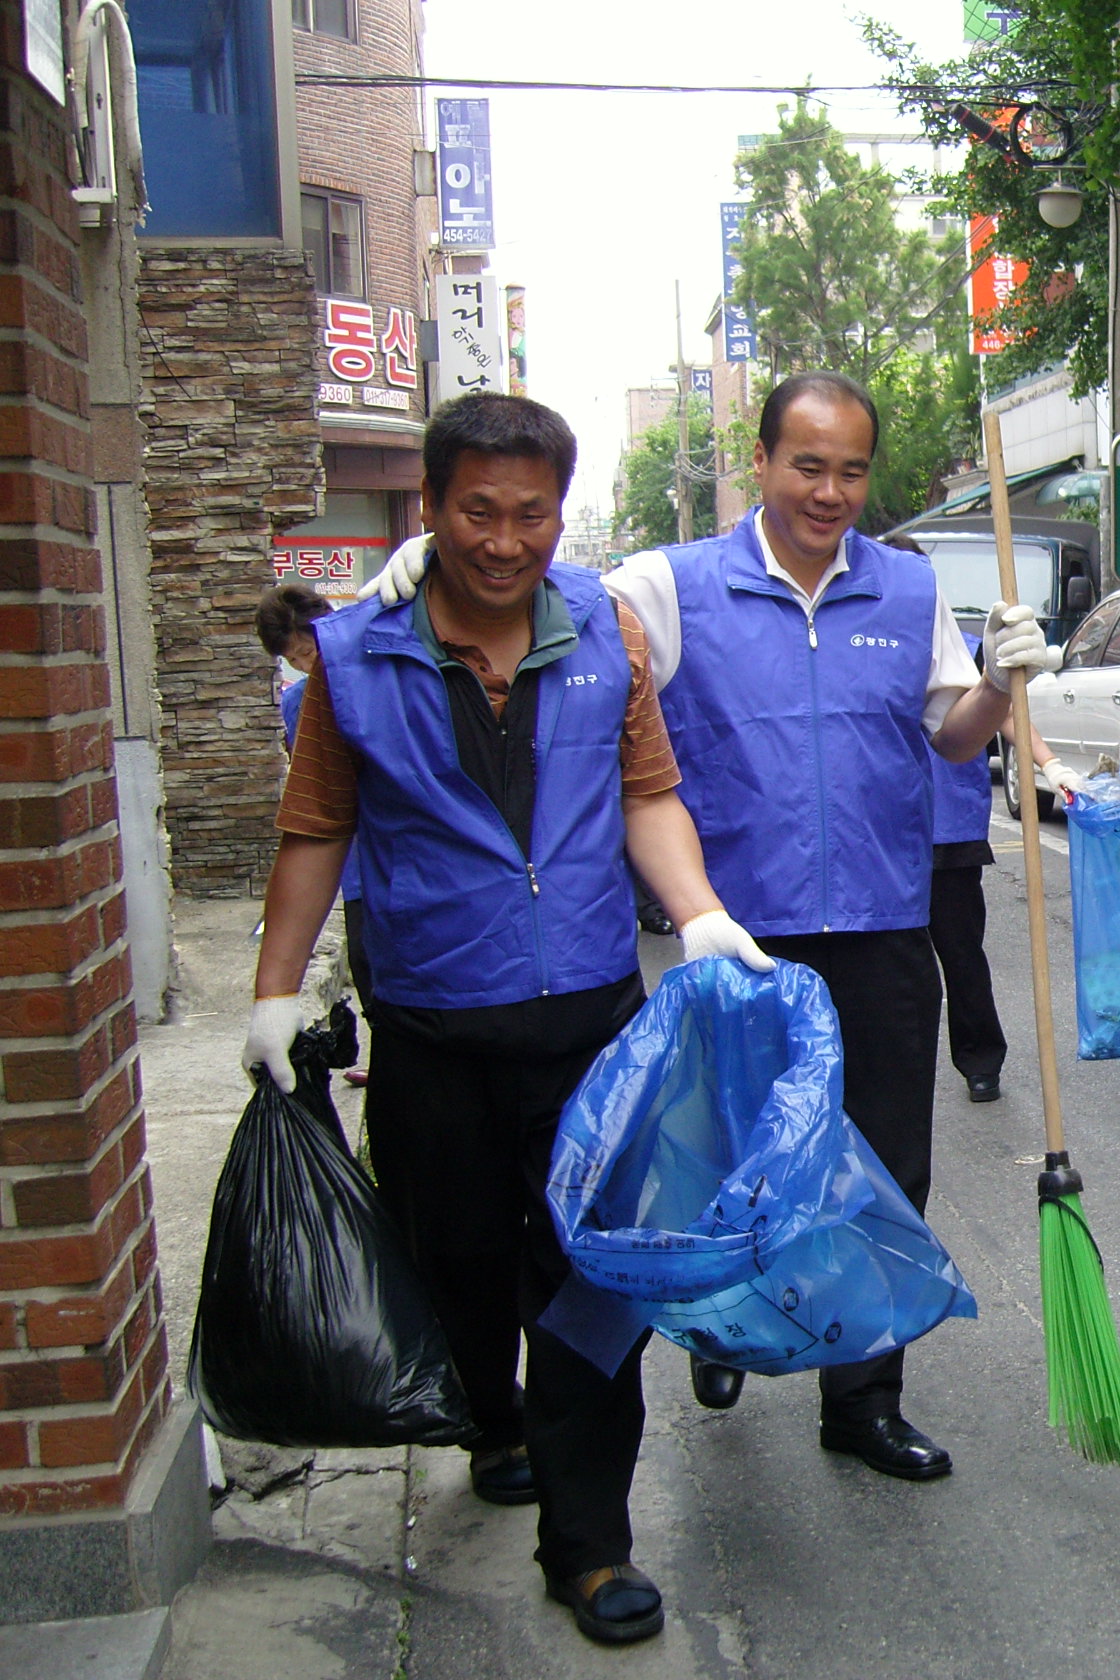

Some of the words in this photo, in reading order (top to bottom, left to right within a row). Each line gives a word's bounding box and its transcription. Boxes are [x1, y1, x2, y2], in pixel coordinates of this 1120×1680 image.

[444, 229, 491, 242] 454-5427
[452, 282, 484, 328] 머리
[273, 550, 356, 579] 부동산
[866, 636, 899, 648] 광진구
